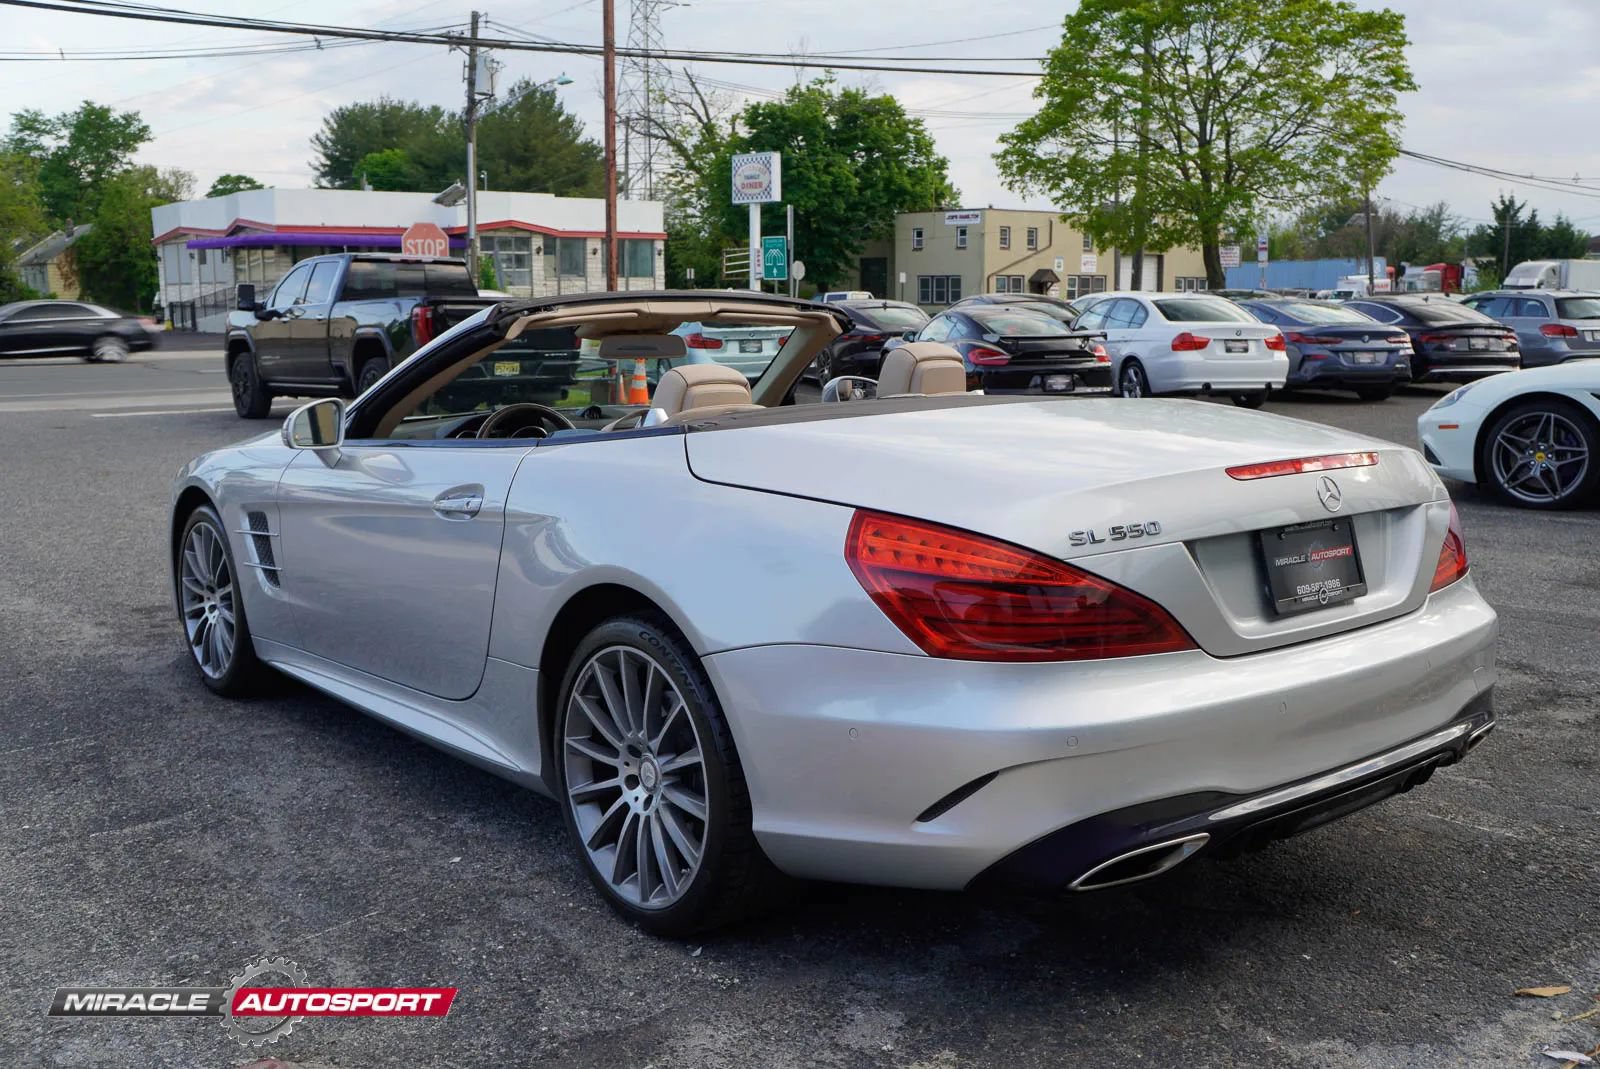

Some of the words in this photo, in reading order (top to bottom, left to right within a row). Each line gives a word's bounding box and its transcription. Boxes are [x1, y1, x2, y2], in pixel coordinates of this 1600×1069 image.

[741, 181, 763, 190] DINER
[406, 238, 446, 257] STOP
[1069, 530, 1106, 547] SL
[1109, 521, 1161, 541] 550
[1275, 554, 1306, 567] MIRACLE
[1311, 547, 1351, 560] AUTOSPORT
